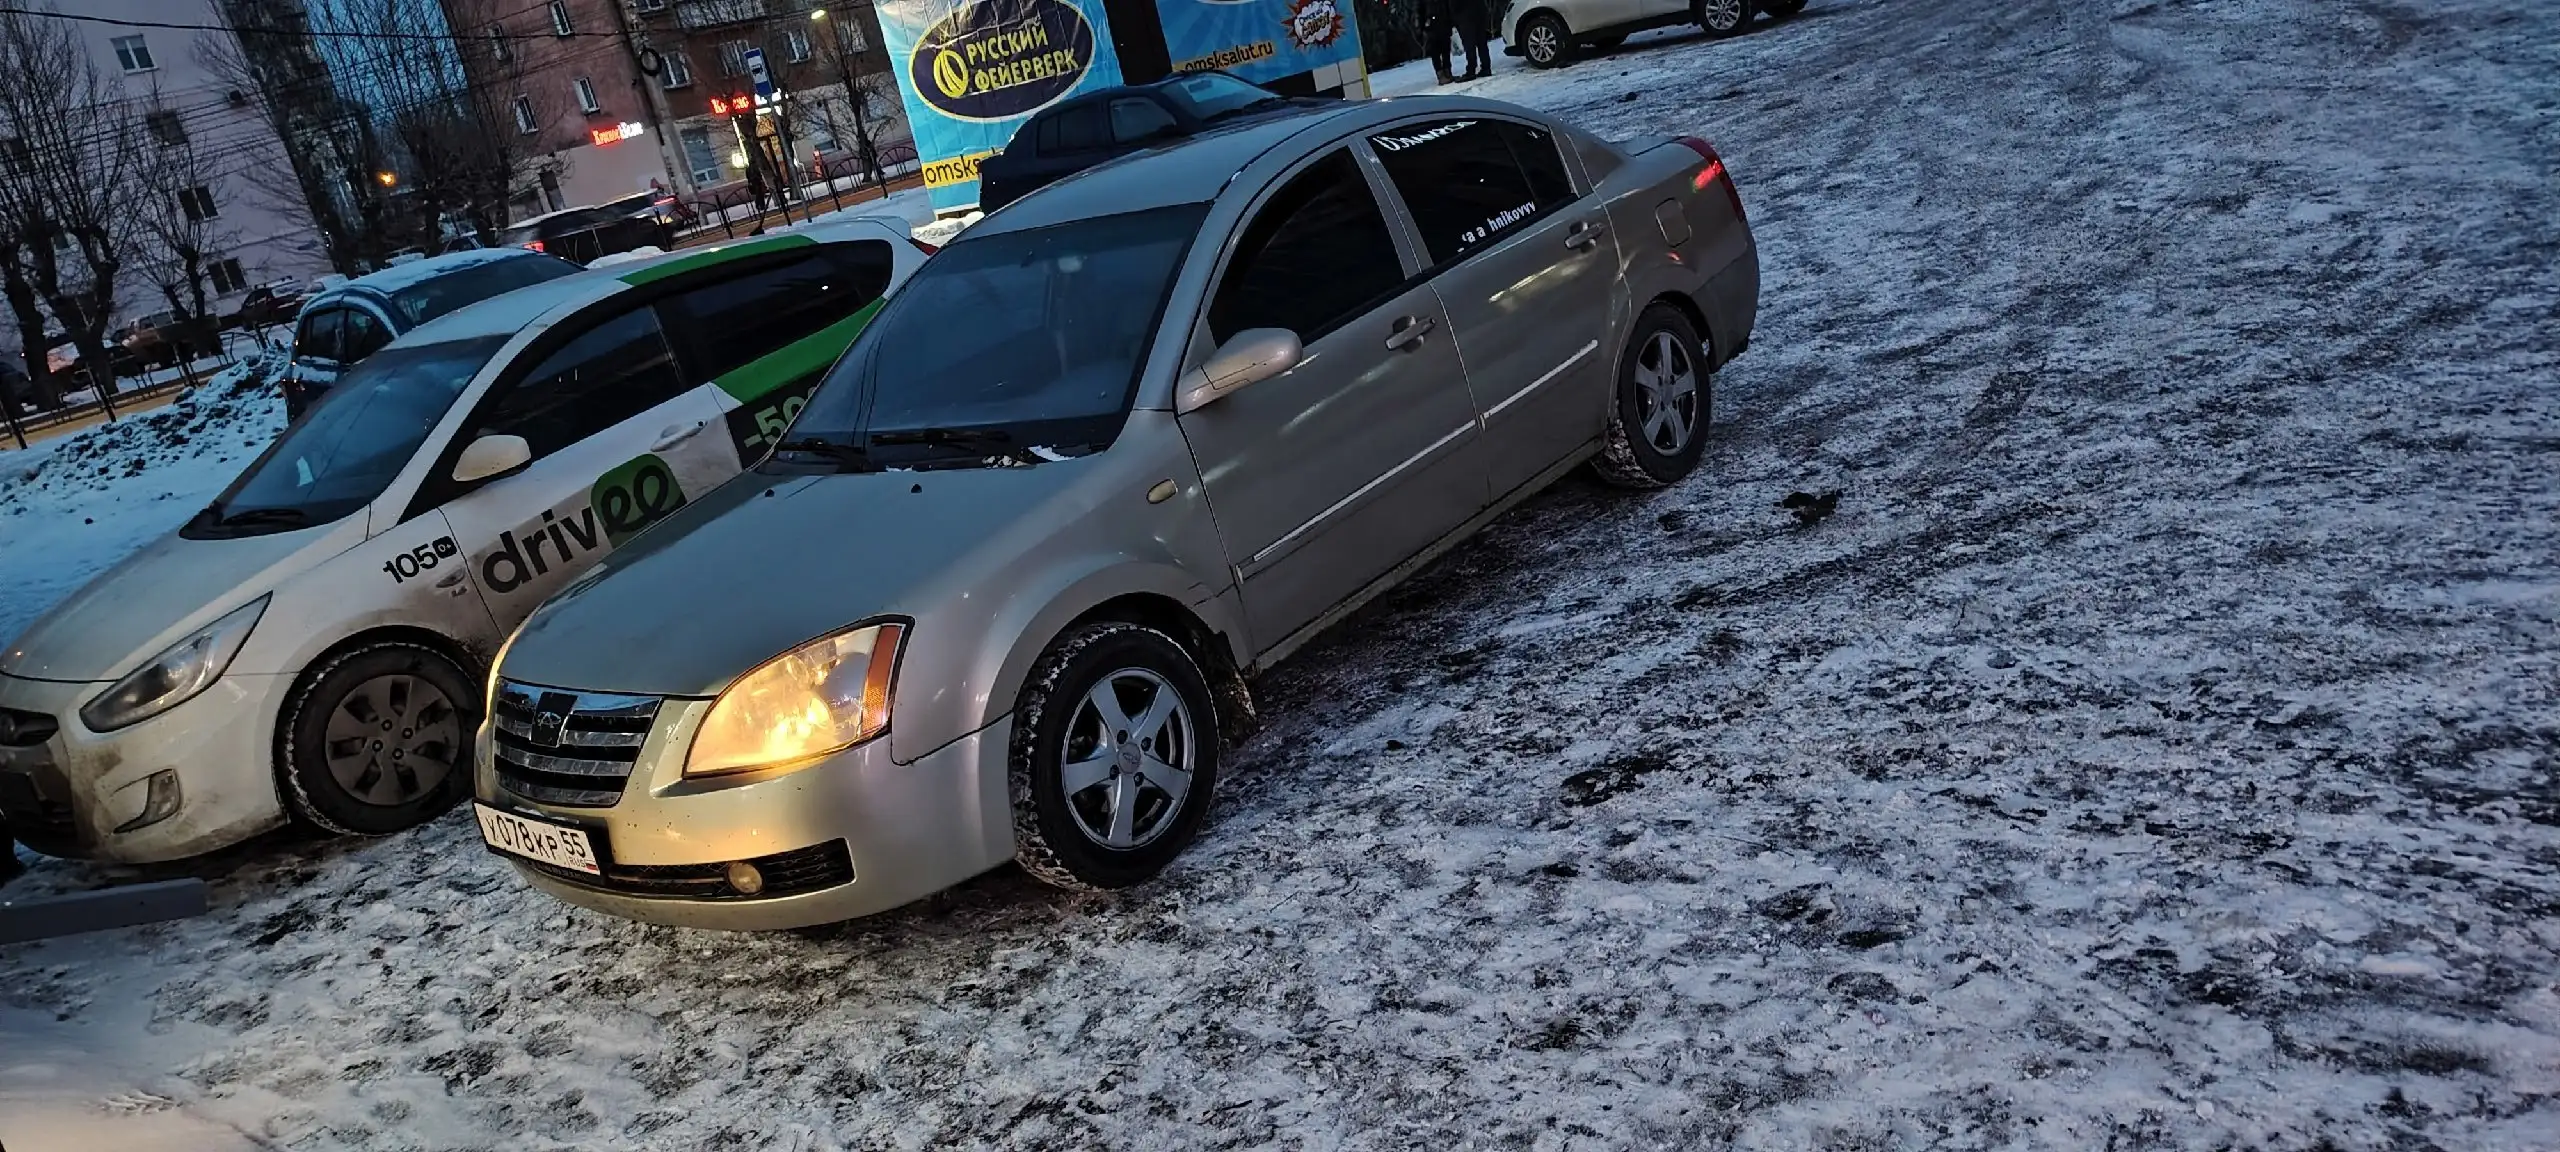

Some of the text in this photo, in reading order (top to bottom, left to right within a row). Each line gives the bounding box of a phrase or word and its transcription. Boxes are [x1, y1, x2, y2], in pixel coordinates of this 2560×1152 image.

[966, 22, 1049, 66] РУССКИЙ
[1185, 41, 1273, 71] omsksalut.ru
[974, 47, 1079, 91] ФЕЙЕРВЕРК
[925, 147, 996, 184] omsks
[743, 386, 817, 448] -50
[483, 465, 687, 593] drivee
[383, 543, 439, 583] 105
[485, 814, 586, 861] У078КР 55
[568, 857, 587, 868] RUS
